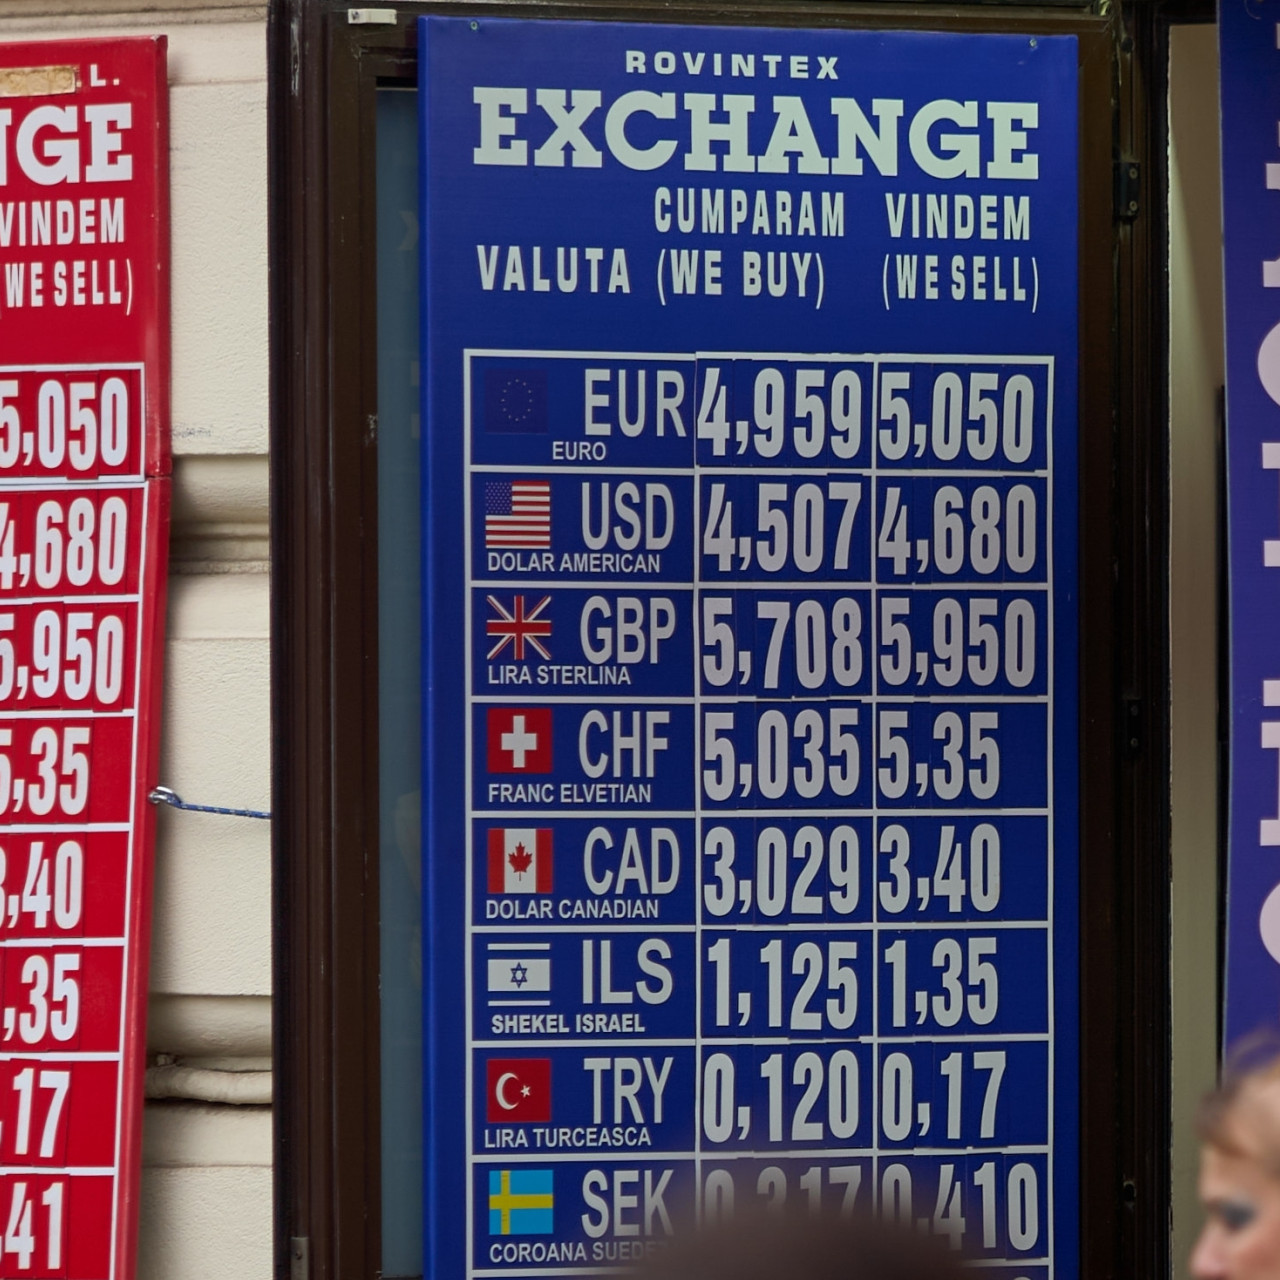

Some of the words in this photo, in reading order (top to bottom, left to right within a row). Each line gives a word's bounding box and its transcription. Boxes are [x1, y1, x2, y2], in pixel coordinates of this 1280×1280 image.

[626, 50, 840, 80] ROVINTEX
[473, 86, 1040, 180] EXCHANGE
[654, 187, 845, 237] CUMPARAM
[885, 193, 1030, 241] VINDEM
[53, 259, 133, 316] SELL)
[477, 245, 631, 294] VALUTA
[657, 249, 722, 305] (WE
[744, 252, 824, 310] BUY)
[883, 254, 939, 310] (WE
[952, 256, 1039, 313] SELL)
[584, 368, 687, 437] EUR
[696, 368, 863, 459] 4,959
[879, 371, 1035, 463] 5,050
[552, 441, 607, 462] EURO
[581, 482, 675, 551] USD
[703, 482, 862, 573] 4,507
[878, 484, 1037, 576] 4,680
[487, 553, 555, 572] DOLAR
[559, 553, 661, 574] AMERICAN
[580, 596, 676, 665] GBP
[702, 596, 863, 690] 5,708
[880, 597, 1036, 688] 5,950
[488, 666, 532, 685] LIRA
[536, 666, 631, 686] STERLINA
[578, 710, 670, 779] CHF
[703, 707, 861, 801] 5,035
[878, 710, 999, 800] 5,35
[488, 784, 556, 803] FRANC
[560, 784, 651, 803] ELVETIAN
[583, 826, 681, 895] CAD
[703, 825, 861, 917] 3,029
[879, 823, 1001, 914] 3,40
[486, 900, 554, 920] DOLAR
[558, 899, 659, 919] CANADIAN
[582, 938, 674, 1005] ILS
[708, 938, 858, 1031] 1,125
[884, 937, 998, 1028] 1,35
[491, 1015, 570, 1034] SHEKEL
[575, 1014, 645, 1033] ISRAEL
[583, 1056, 674, 1124] TRY
[703, 1049, 861, 1143] 0,120
[881, 1050, 1006, 1142] 0,17
[484, 1129, 529, 1149] LIRA
[533, 1127, 651, 1148] TURCEASCA
[581, 1169, 674, 1238] SEK
[489, 1242, 587, 1263] COROANA
